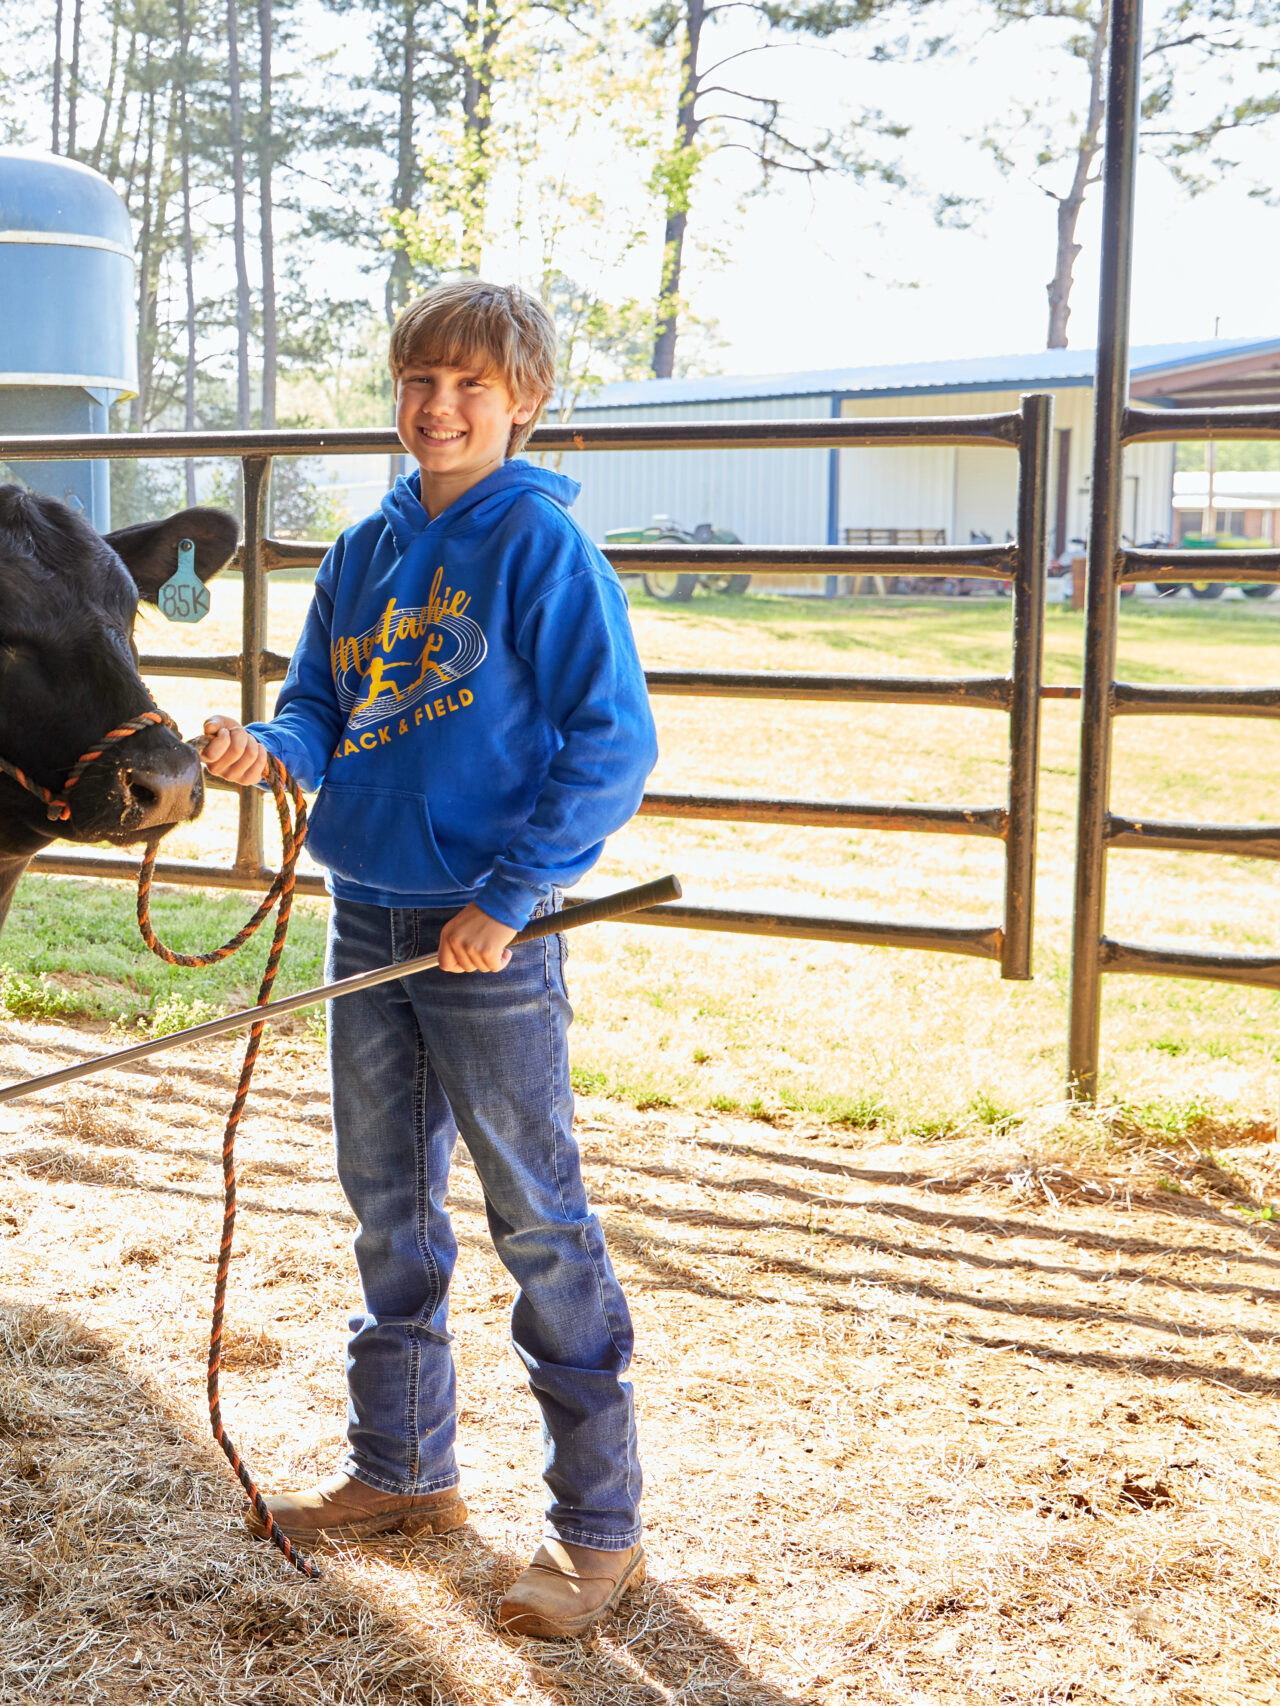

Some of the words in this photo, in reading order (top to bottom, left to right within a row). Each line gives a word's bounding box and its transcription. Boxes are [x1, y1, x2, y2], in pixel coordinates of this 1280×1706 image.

[162, 583, 209, 618] 85K
[333, 725, 392, 759] ACK
[398, 718, 409, 735] &
[414, 688, 474, 726] FIELD
